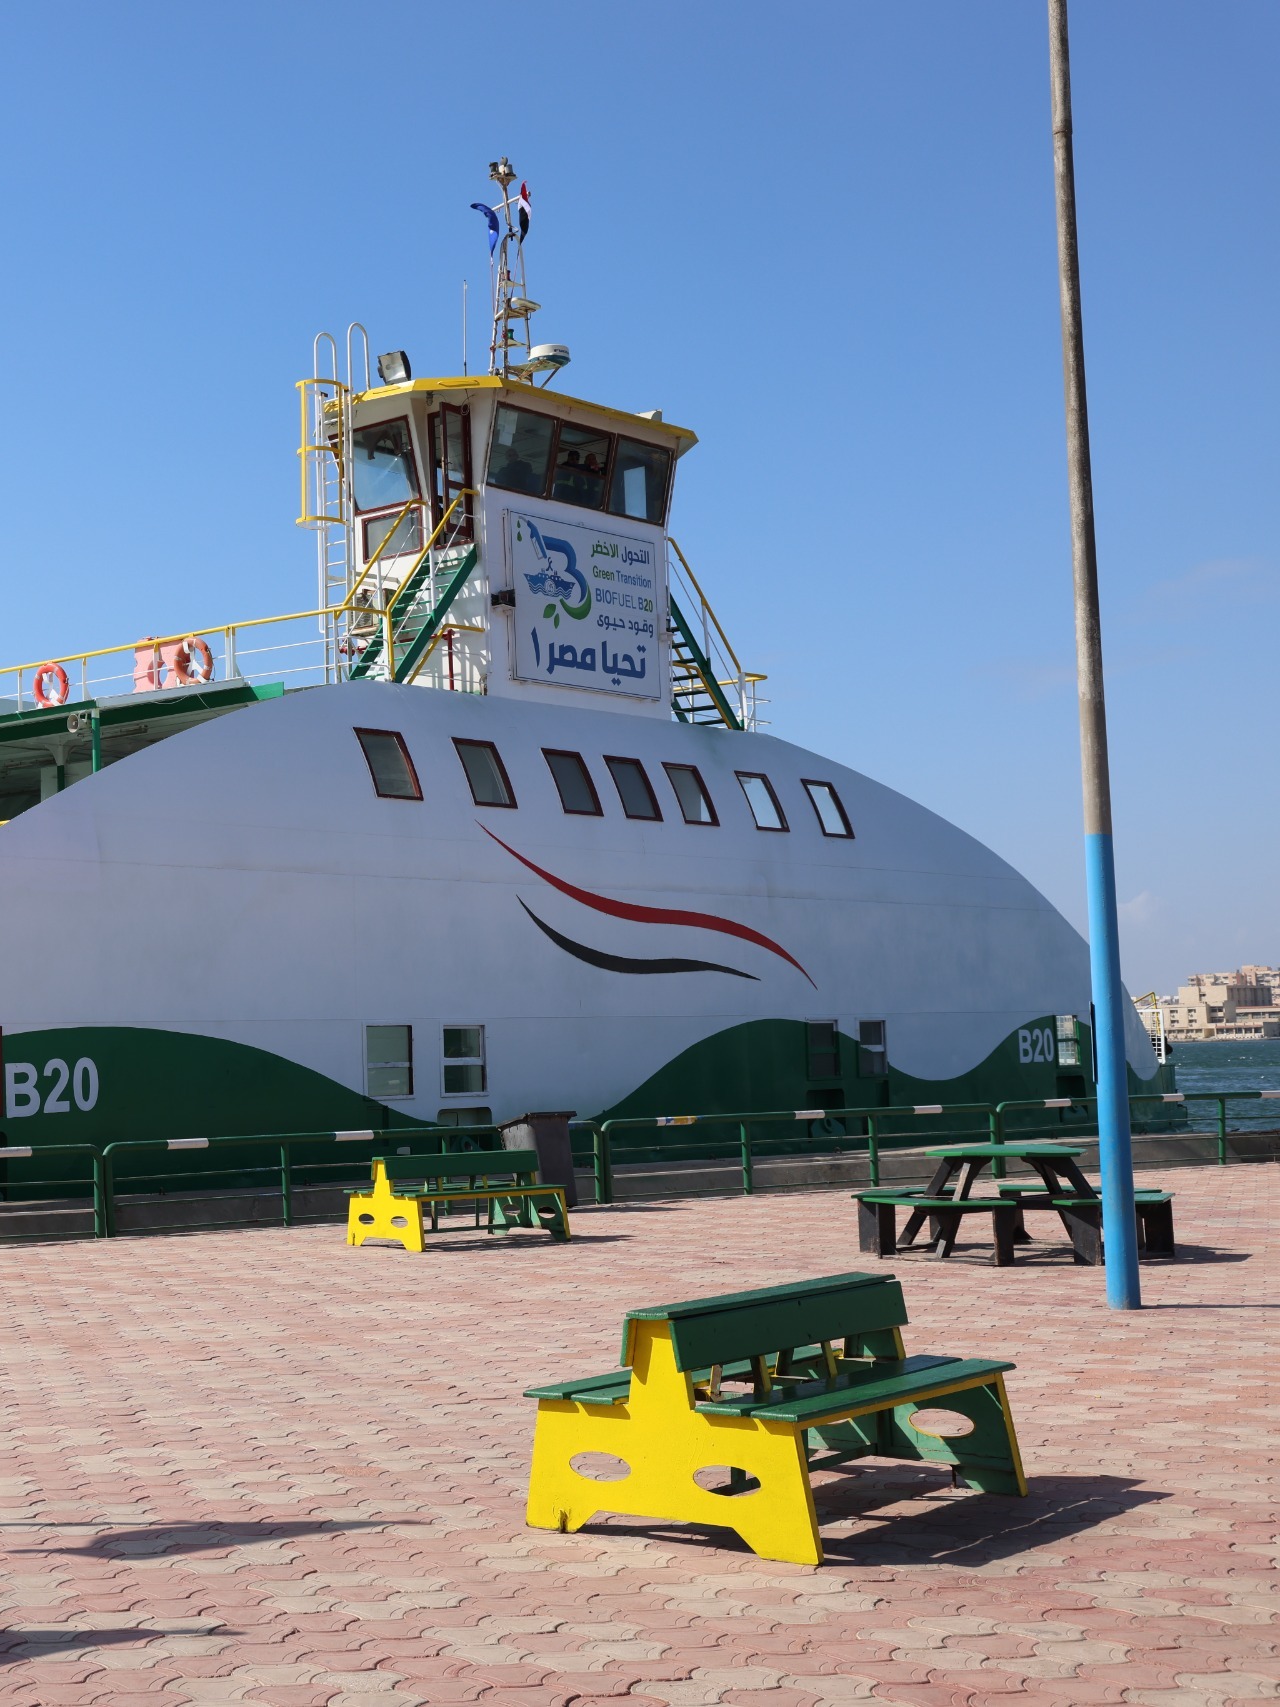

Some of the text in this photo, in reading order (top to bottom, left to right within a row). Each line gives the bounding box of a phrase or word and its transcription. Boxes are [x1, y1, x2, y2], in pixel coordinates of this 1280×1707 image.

[621, 546, 650, 566] التحول
[592, 565, 652, 589] Green Transition
[595, 587, 654, 613] BIOFUEL B20
[628, 619, 654, 638] وقود
[546, 641, 596, 675] مصر
[601, 640, 647, 686] تحيا
[1018, 1027, 1055, 1064] B20
[5, 1056, 99, 1119] B20
